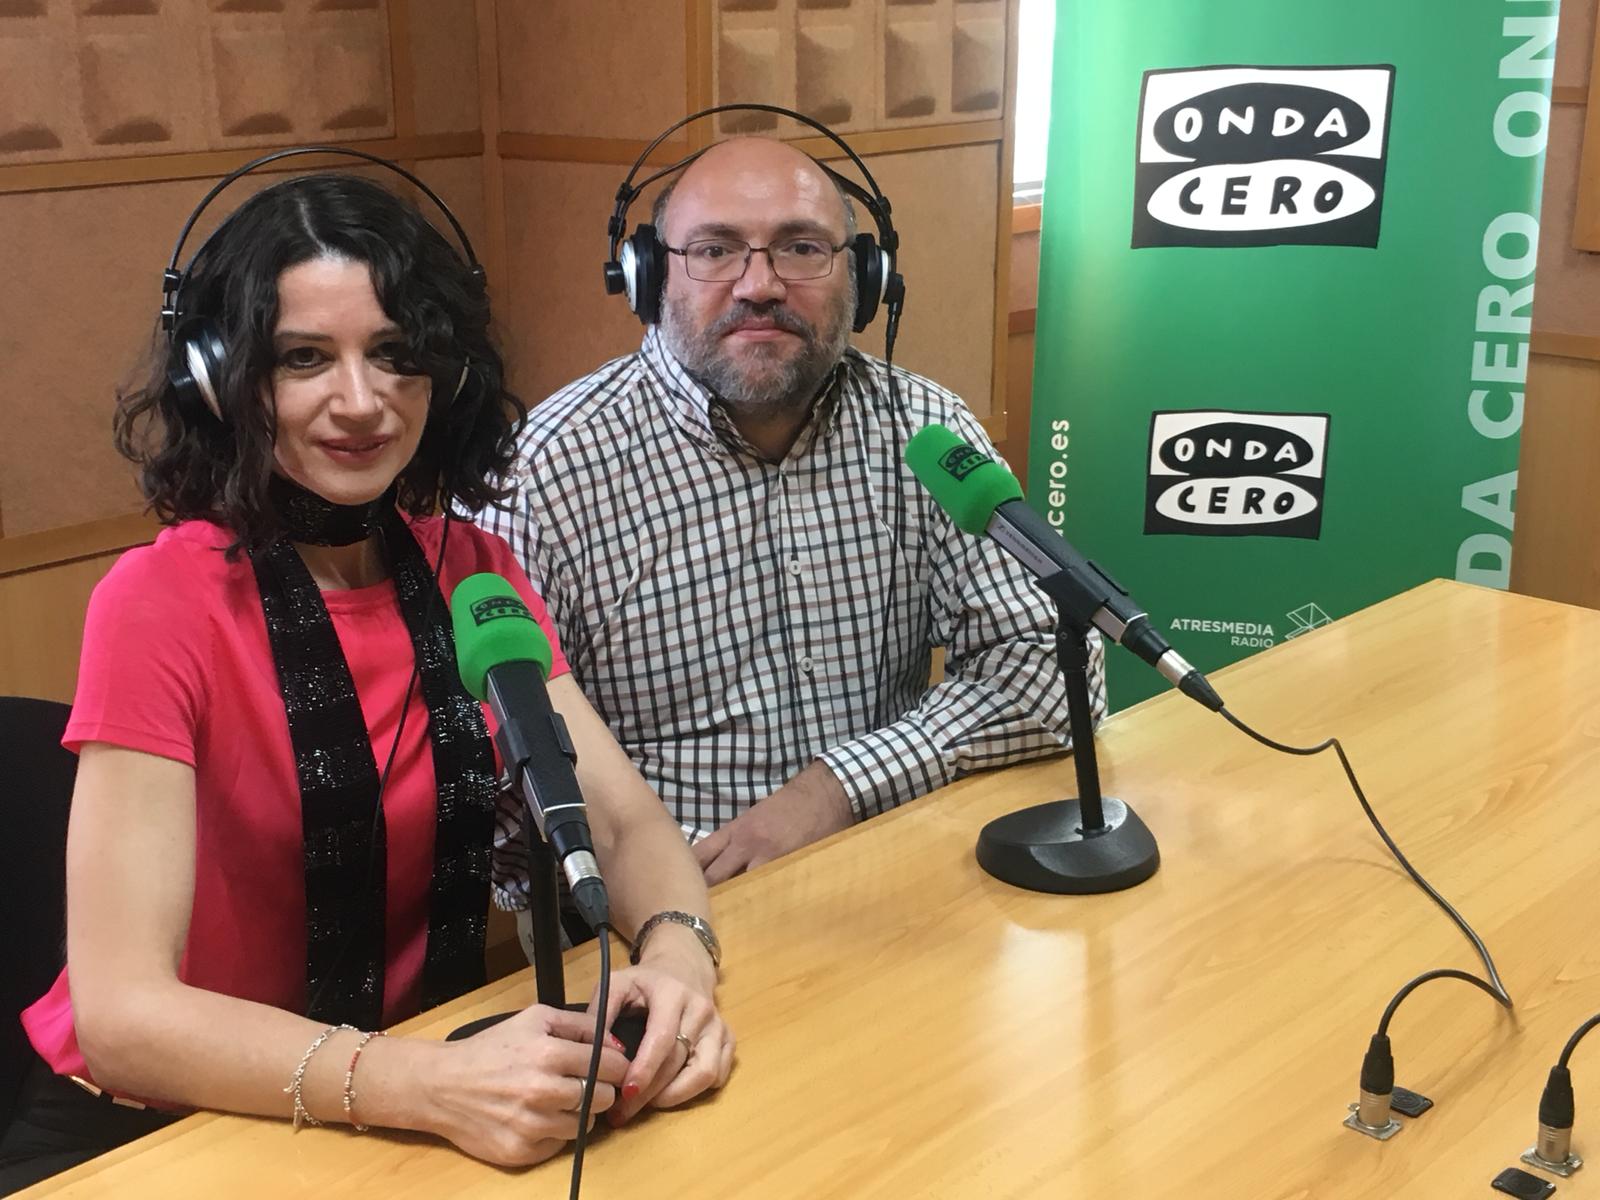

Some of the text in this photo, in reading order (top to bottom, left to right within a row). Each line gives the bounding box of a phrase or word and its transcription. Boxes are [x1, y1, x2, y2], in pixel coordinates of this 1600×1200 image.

[1493, 0, 1561, 158] ON
[1173, 105, 1348, 143] ONDA
[1178, 175, 1344, 216] CERO
[1467, 211, 1540, 439] CERO
[1174, 437, 1298, 463] ONDA
[1047, 419, 1070, 537] cero.es
[1177, 485, 1296, 515] CERO
[1169, 617, 1275, 637] ATRESMEDIA
[1230, 636, 1275, 649] RADIO
